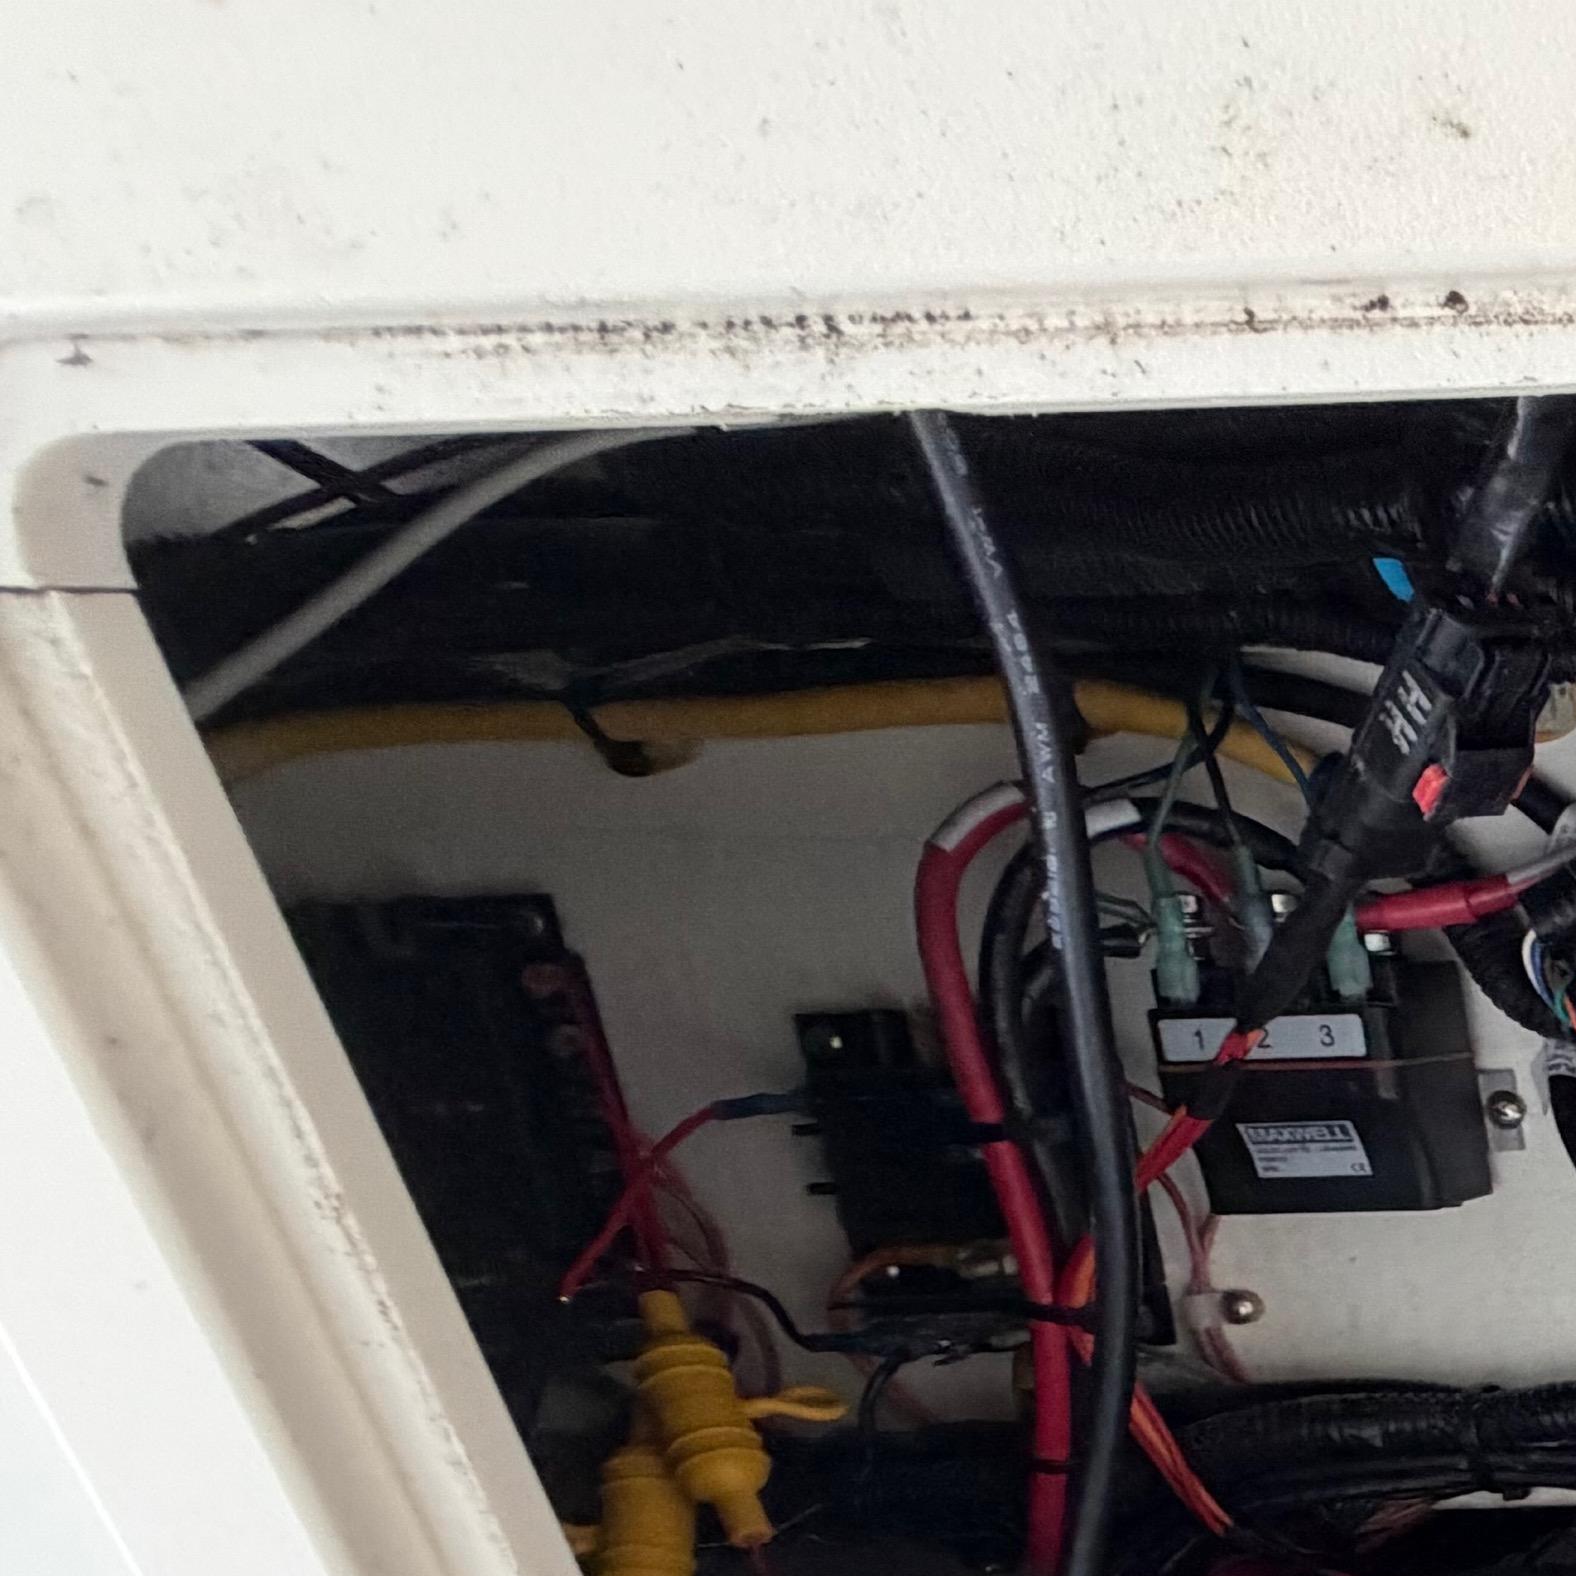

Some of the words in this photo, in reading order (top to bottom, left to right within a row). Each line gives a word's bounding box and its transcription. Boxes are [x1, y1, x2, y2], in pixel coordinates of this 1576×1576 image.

[1195, 1030, 1205, 1051] 1
[1258, 1030, 1272, 1049] 2
[1319, 1024, 1336, 1047] 3
